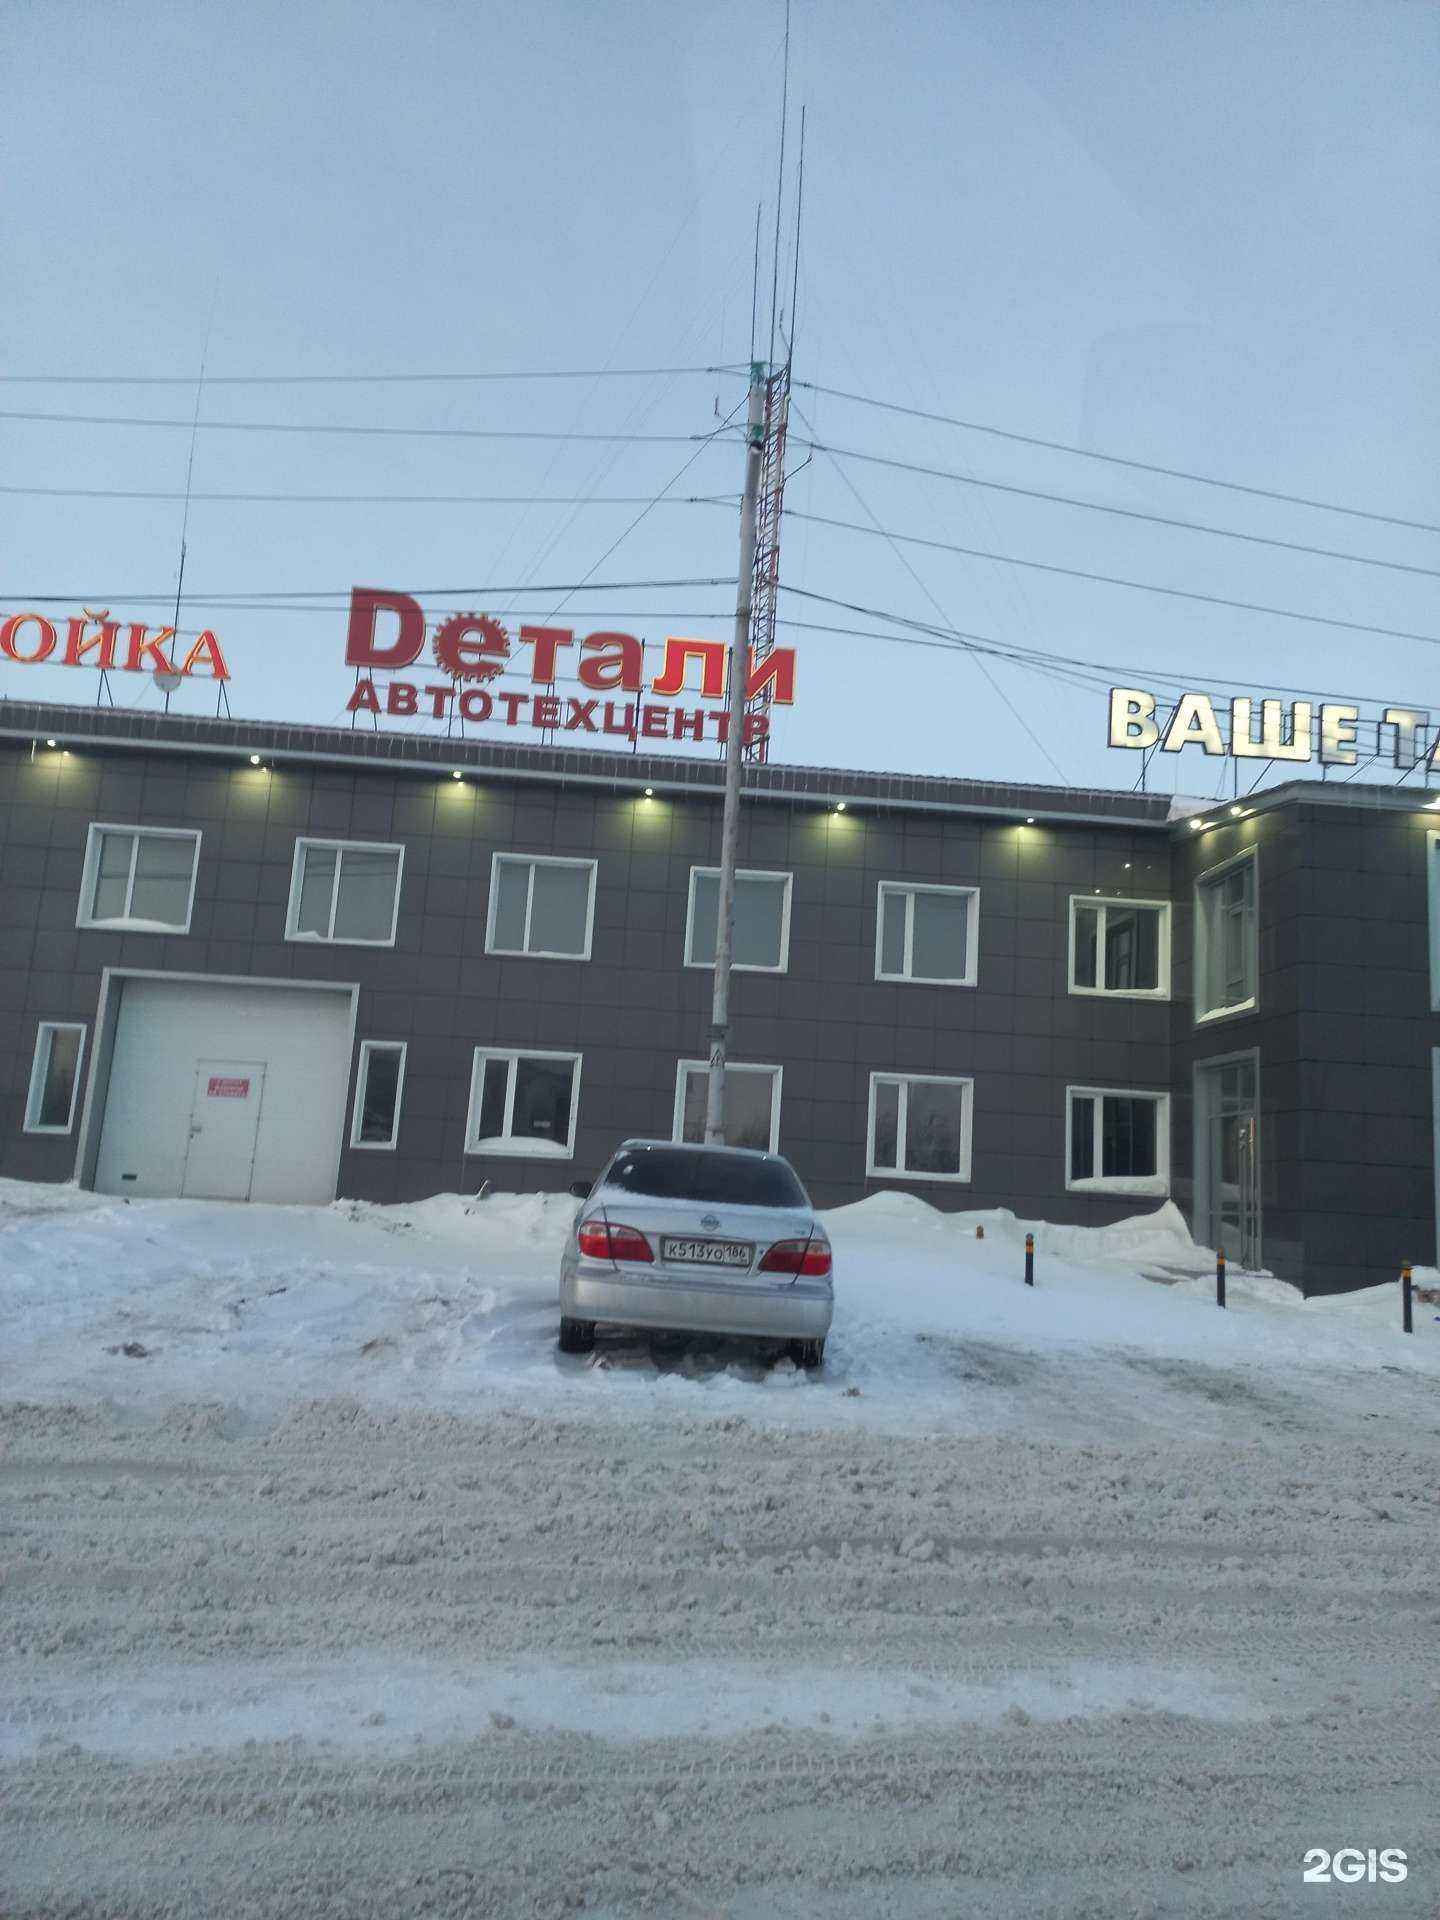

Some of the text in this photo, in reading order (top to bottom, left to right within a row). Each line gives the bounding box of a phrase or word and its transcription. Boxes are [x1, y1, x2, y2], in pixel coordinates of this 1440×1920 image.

[346, 678, 770, 746] АВТОТЕХЦЕНТР
[1108, 687, 1440, 773] ВАШЕ Т
